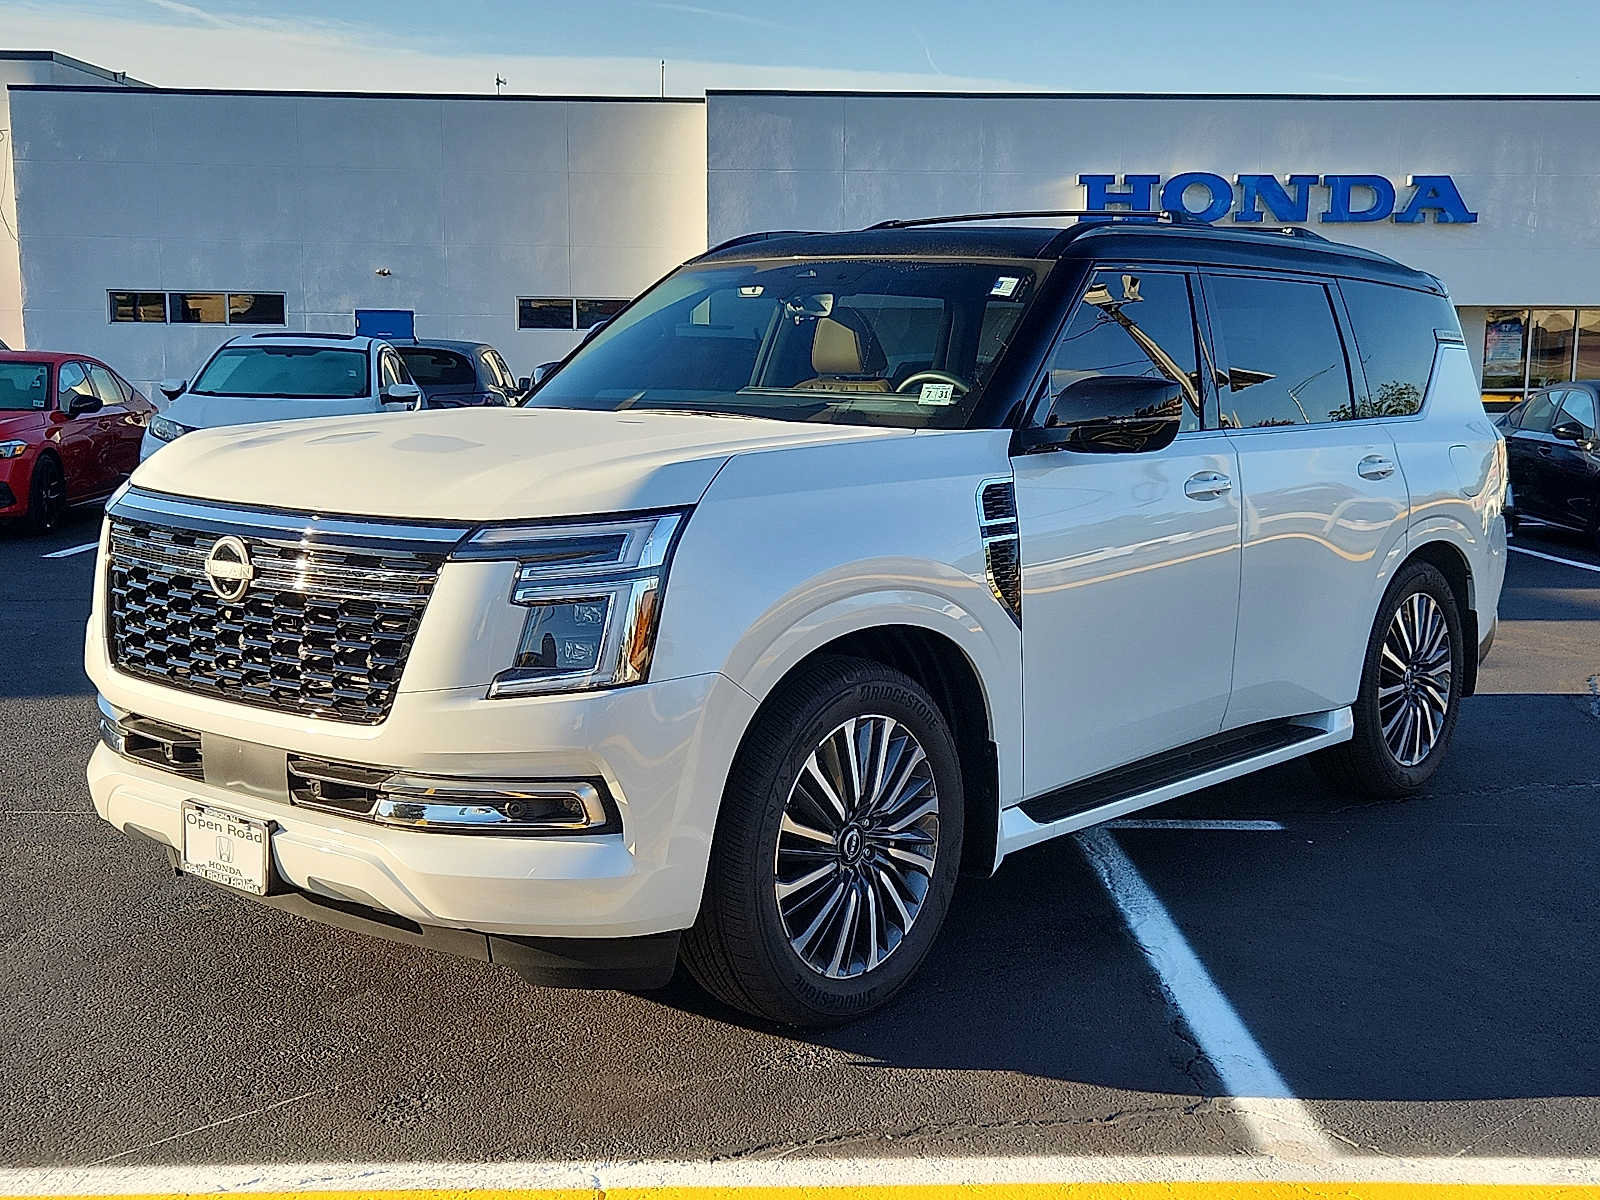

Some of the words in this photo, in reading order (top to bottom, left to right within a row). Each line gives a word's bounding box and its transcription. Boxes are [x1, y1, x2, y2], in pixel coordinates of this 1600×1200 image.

[1076, 171, 1479, 224] HONDA
[926, 390, 933, 399] 7
[938, 390, 949, 399] 31
[186, 813, 222, 833] Open
[227, 824, 262, 843] Road
[208, 860, 243, 877] HONDA
